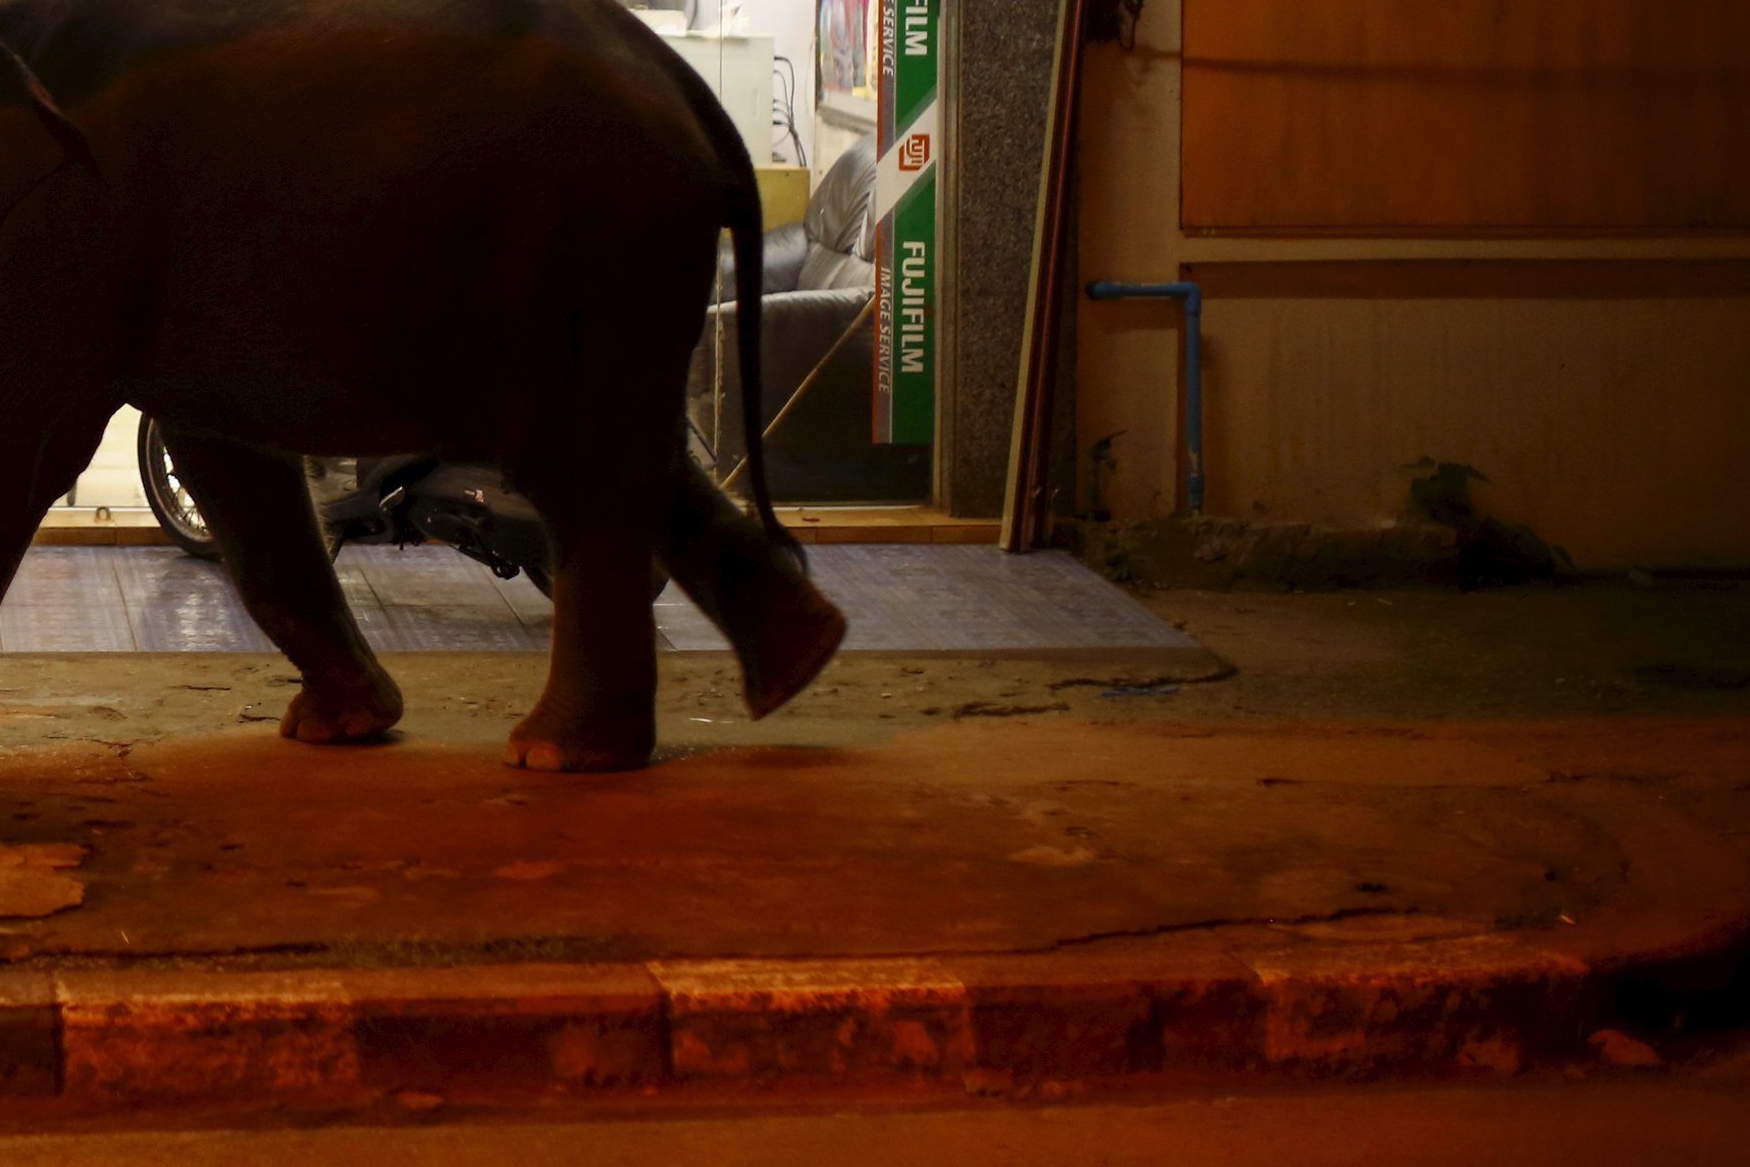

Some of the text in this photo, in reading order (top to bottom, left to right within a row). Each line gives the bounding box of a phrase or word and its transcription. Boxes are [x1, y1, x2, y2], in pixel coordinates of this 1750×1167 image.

[882, 7, 894, 76] SERVICE
[879, 266, 891, 394] IMAGE SERVICE
[901, 240, 925, 374] FUJIFILM
